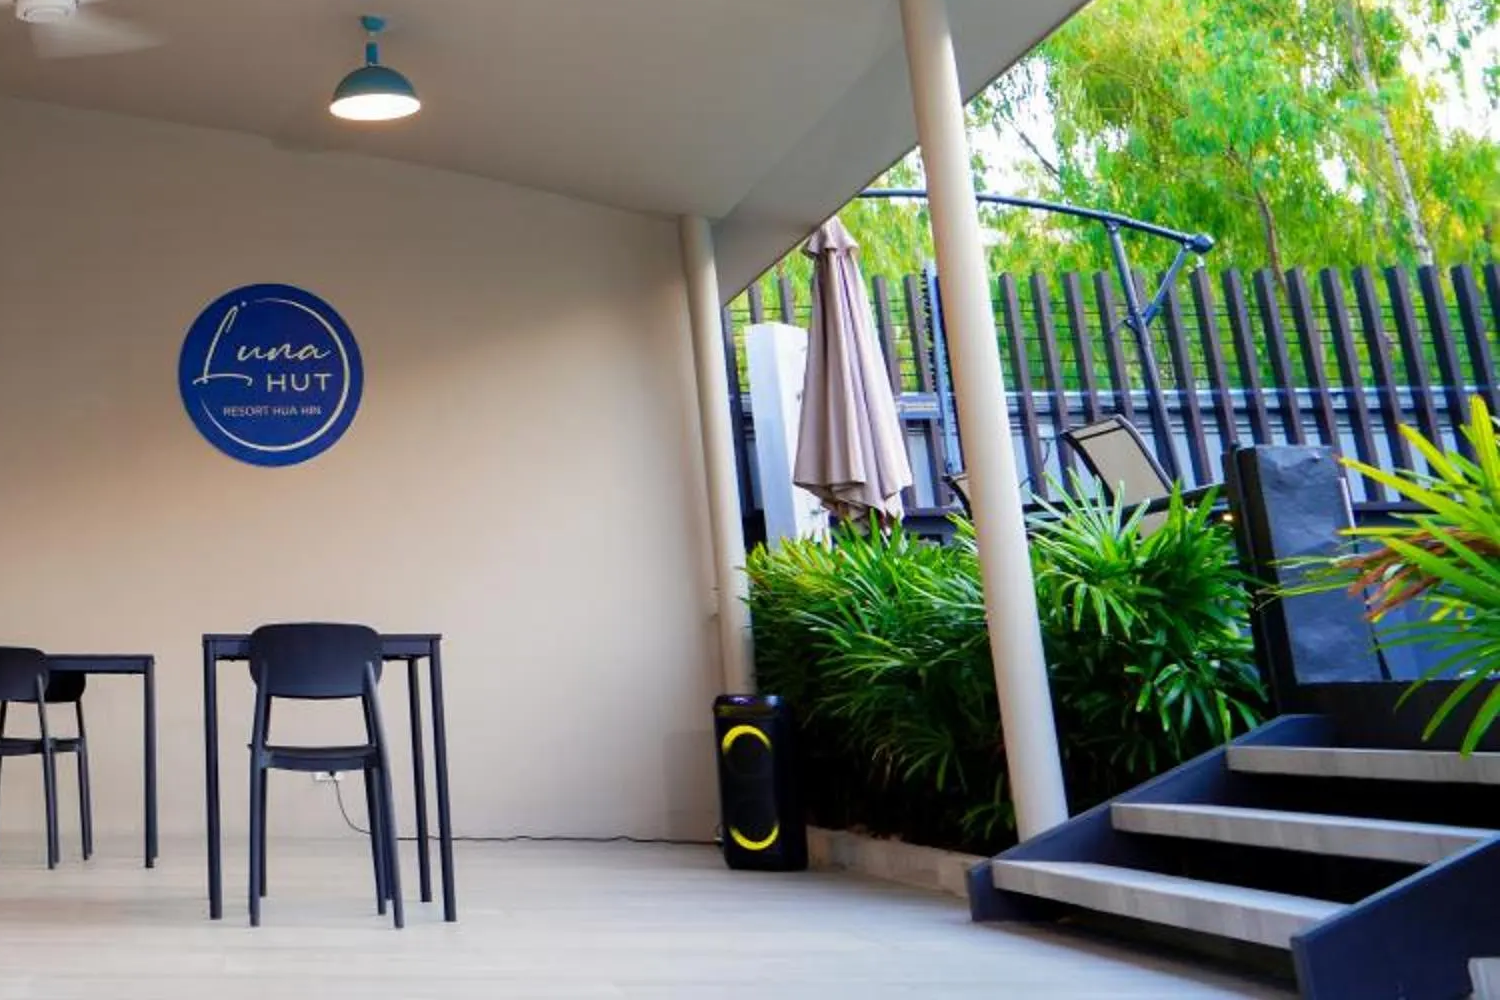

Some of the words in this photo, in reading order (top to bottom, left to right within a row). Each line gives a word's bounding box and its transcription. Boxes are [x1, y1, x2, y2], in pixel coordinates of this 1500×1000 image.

[192, 304, 331, 386] Luna
[266, 373, 332, 392] HUT
[223, 406, 268, 416] RESORT
[273, 406, 298, 416] HUA
[301, 406, 321, 416] HIN
